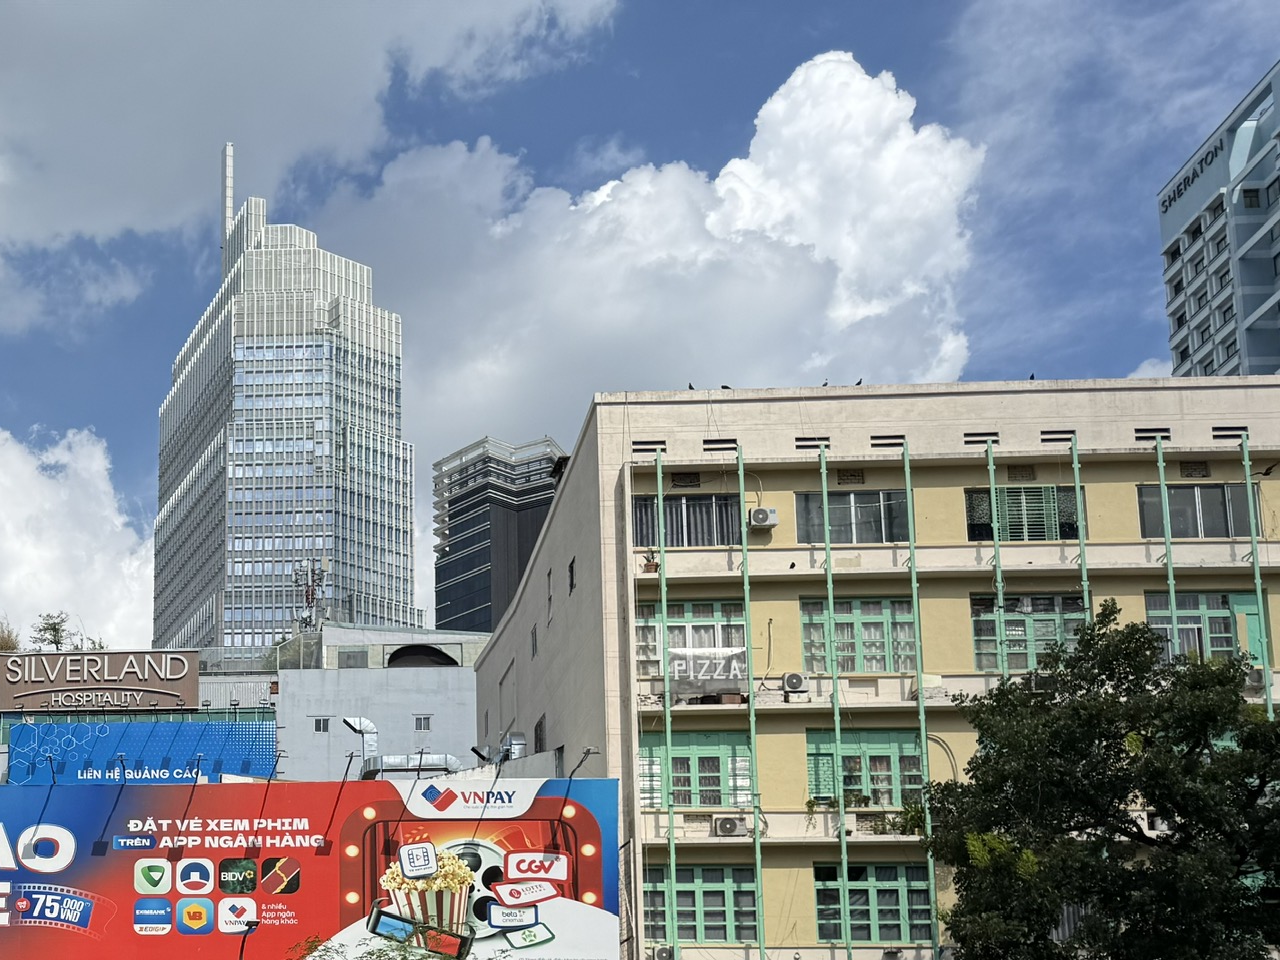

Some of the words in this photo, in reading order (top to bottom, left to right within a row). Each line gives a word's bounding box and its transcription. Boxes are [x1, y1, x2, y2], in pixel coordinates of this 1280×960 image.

[1161, 138, 1224, 214] SHERATON
[5, 654, 189, 683] SILVERLAND
[674, 659, 742, 680] PIZZA
[51, 692, 143, 707] HOSPITALITY
[77, 768, 101, 780] LIÊN
[105, 767, 120, 782] HỆ
[125, 765, 170, 779] QUẢNG
[173, 767, 202, 779] CÁO
[460, 791, 516, 804] VNPAY
[128, 817, 173, 834] ĐẶT
[175, 816, 203, 832] VÉ
[205, 819, 250, 832] XEM
[253, 818, 310, 831] PHIM
[118, 837, 151, 847] TRÊN
[159, 836, 202, 848] APP
[205, 834, 262, 848] NGÂN
[266, 832, 325, 848] HÀNG
[516, 859, 554, 874] CGV
[221, 872, 246, 881] BIDV
[521, 884, 544, 893] LOTTE
[267, 902, 287, 910] nhiều
[60, 908, 80, 923] VND
[261, 917, 279, 925] hàng
[277, 910, 296, 919] ngân
